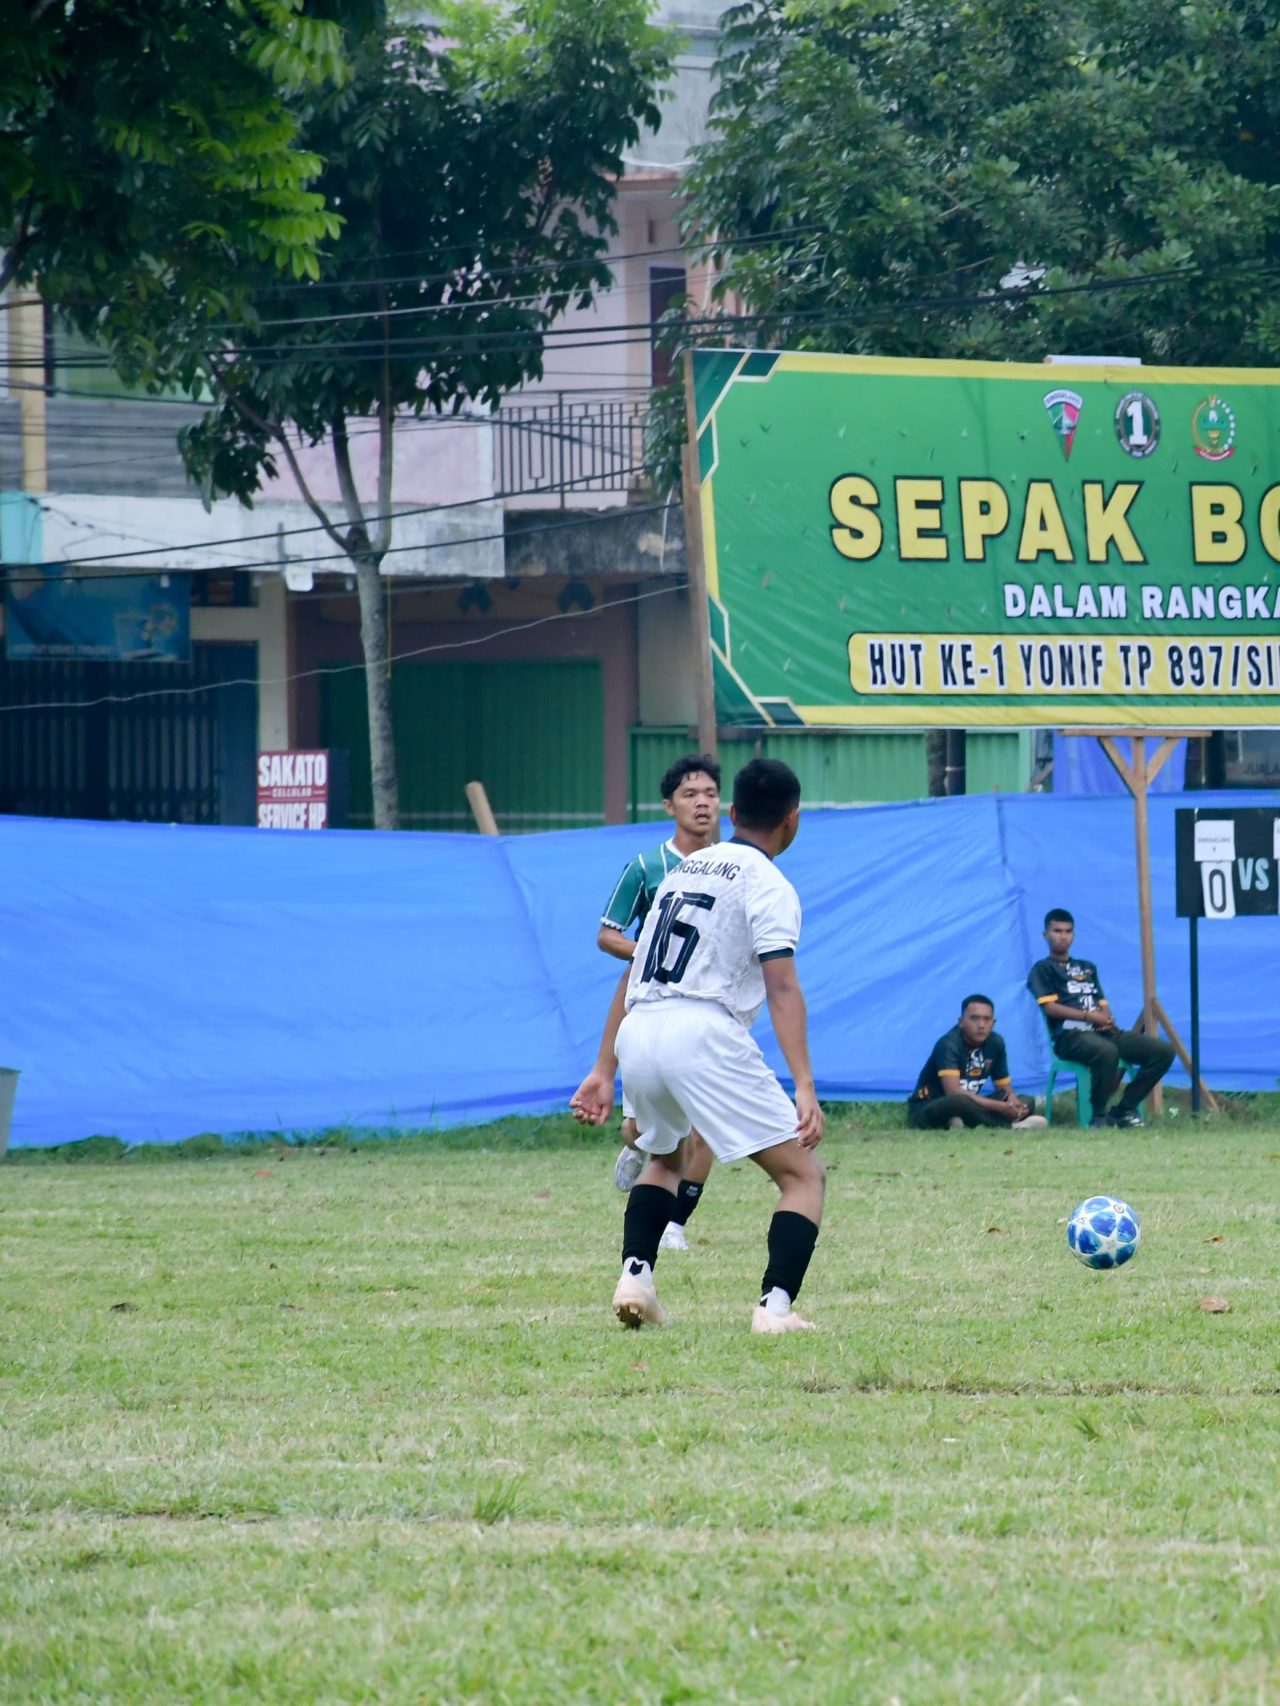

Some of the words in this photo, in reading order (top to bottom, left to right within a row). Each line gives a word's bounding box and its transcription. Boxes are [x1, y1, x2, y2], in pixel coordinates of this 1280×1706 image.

[1126, 401, 1148, 446] 1
[829, 472, 1148, 565] SEPAK
[1003, 583, 1127, 619] DALAM
[868, 641, 923, 687] HUT
[939, 642, 1006, 688] KE-1
[1019, 642, 1104, 688] YONIF
[1118, 643, 1153, 688] TP
[257, 753, 327, 788] SAKATO
[257, 802, 307, 830] SERVICE
[308, 802, 327, 830] HP
[670, 858, 741, 881] NGGALANG
[1236, 857, 1270, 891] VS
[1208, 868, 1227, 913] 0
[640, 890, 717, 985] 16
